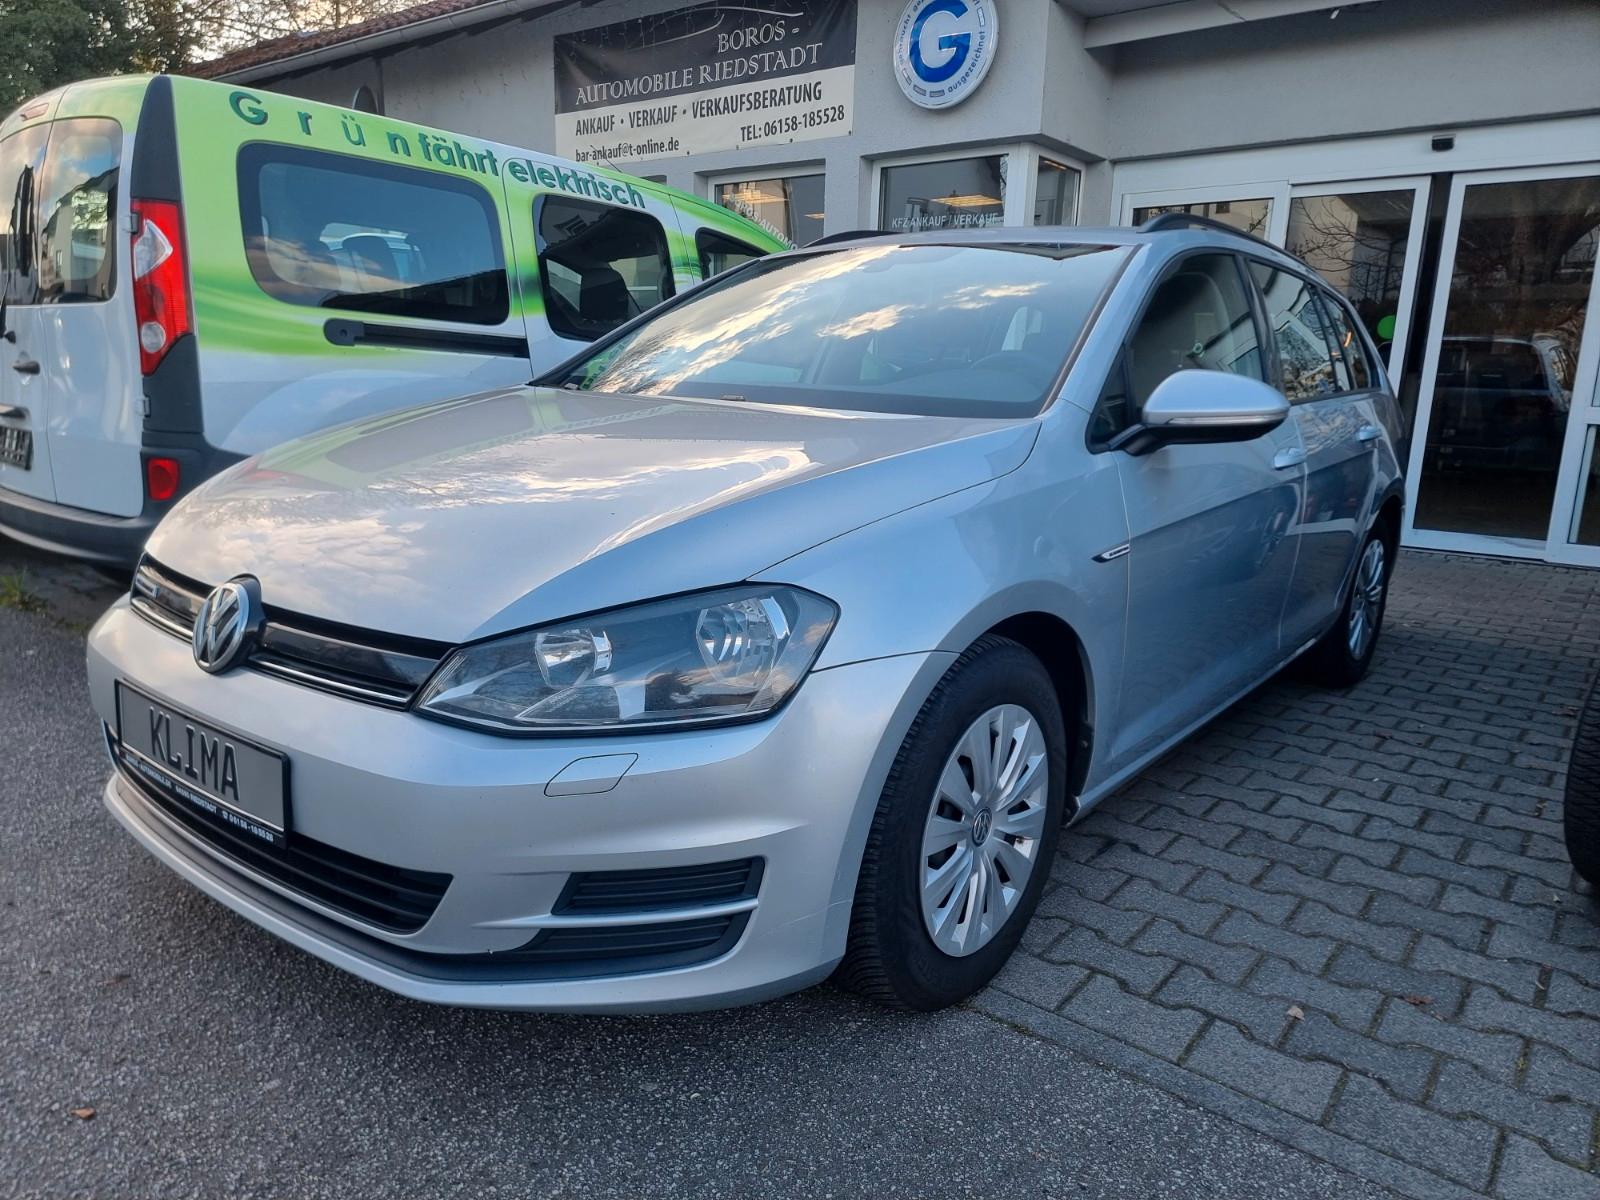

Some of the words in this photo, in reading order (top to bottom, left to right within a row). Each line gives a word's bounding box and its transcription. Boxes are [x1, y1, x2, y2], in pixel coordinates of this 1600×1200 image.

[717, 20, 786, 53] BOROS
[575, 67, 693, 106] AUTOMOBILE
[699, 42, 823, 85] RIEDSTADT
[575, 117, 616, 137] ANKAUF
[628, 104, 678, 129] VERKAUF
[692, 80, 823, 119] VERKAUFSBERATUNG
[418, 133, 500, 177] fährt
[507, 158, 646, 209] elektrisch
[575, 138, 680, 163] bar-ankauf@t-online.de
[149, 705, 240, 801] KLIMA
